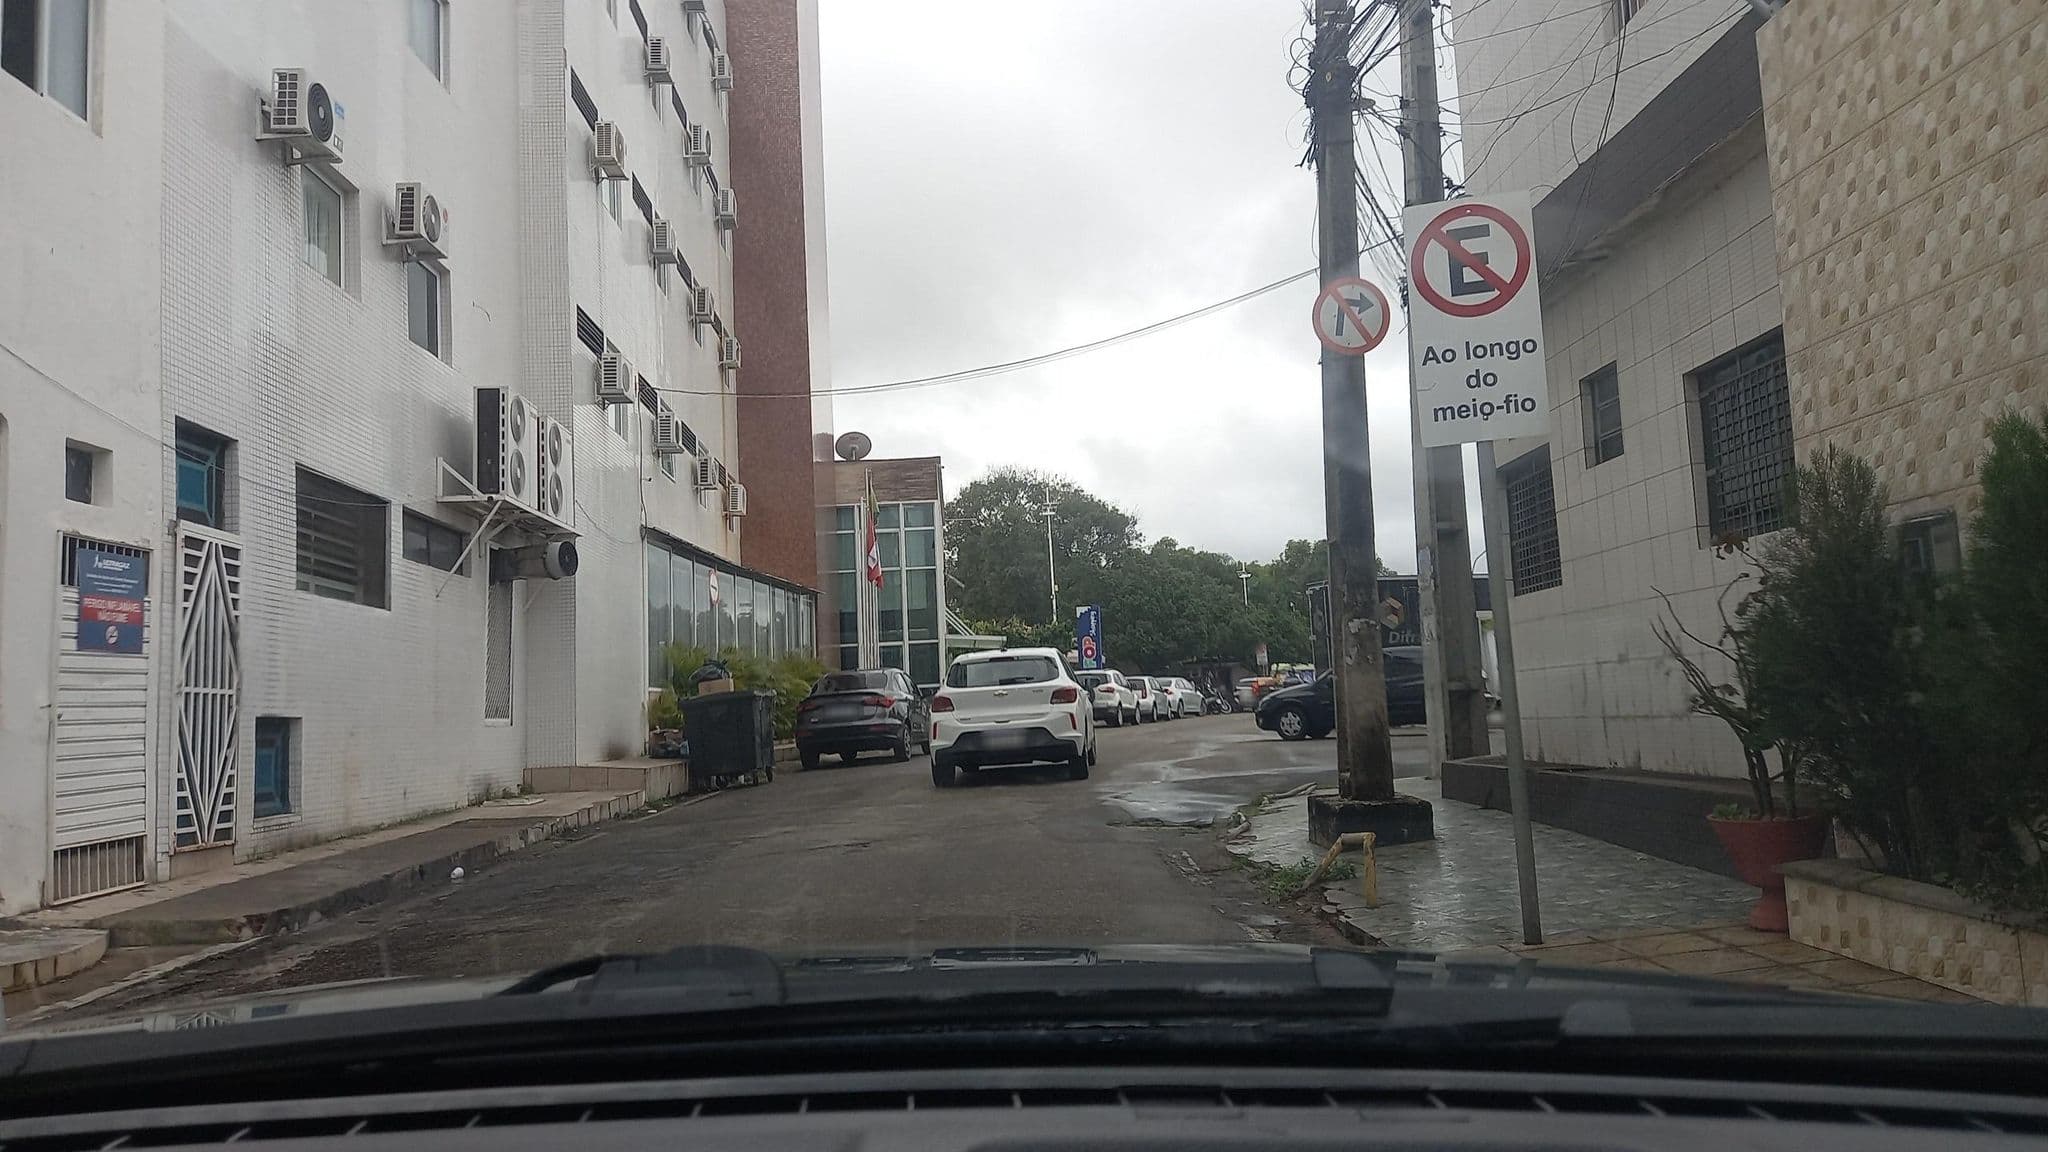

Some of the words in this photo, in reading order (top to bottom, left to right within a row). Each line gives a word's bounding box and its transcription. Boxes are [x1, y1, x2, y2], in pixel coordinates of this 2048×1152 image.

[1446, 223, 1496, 298] E
[1421, 345, 1457, 367] Ao
[1465, 338, 1538, 361] longo
[1465, 368, 1498, 389] do
[1433, 393, 1537, 423] meio-fio
